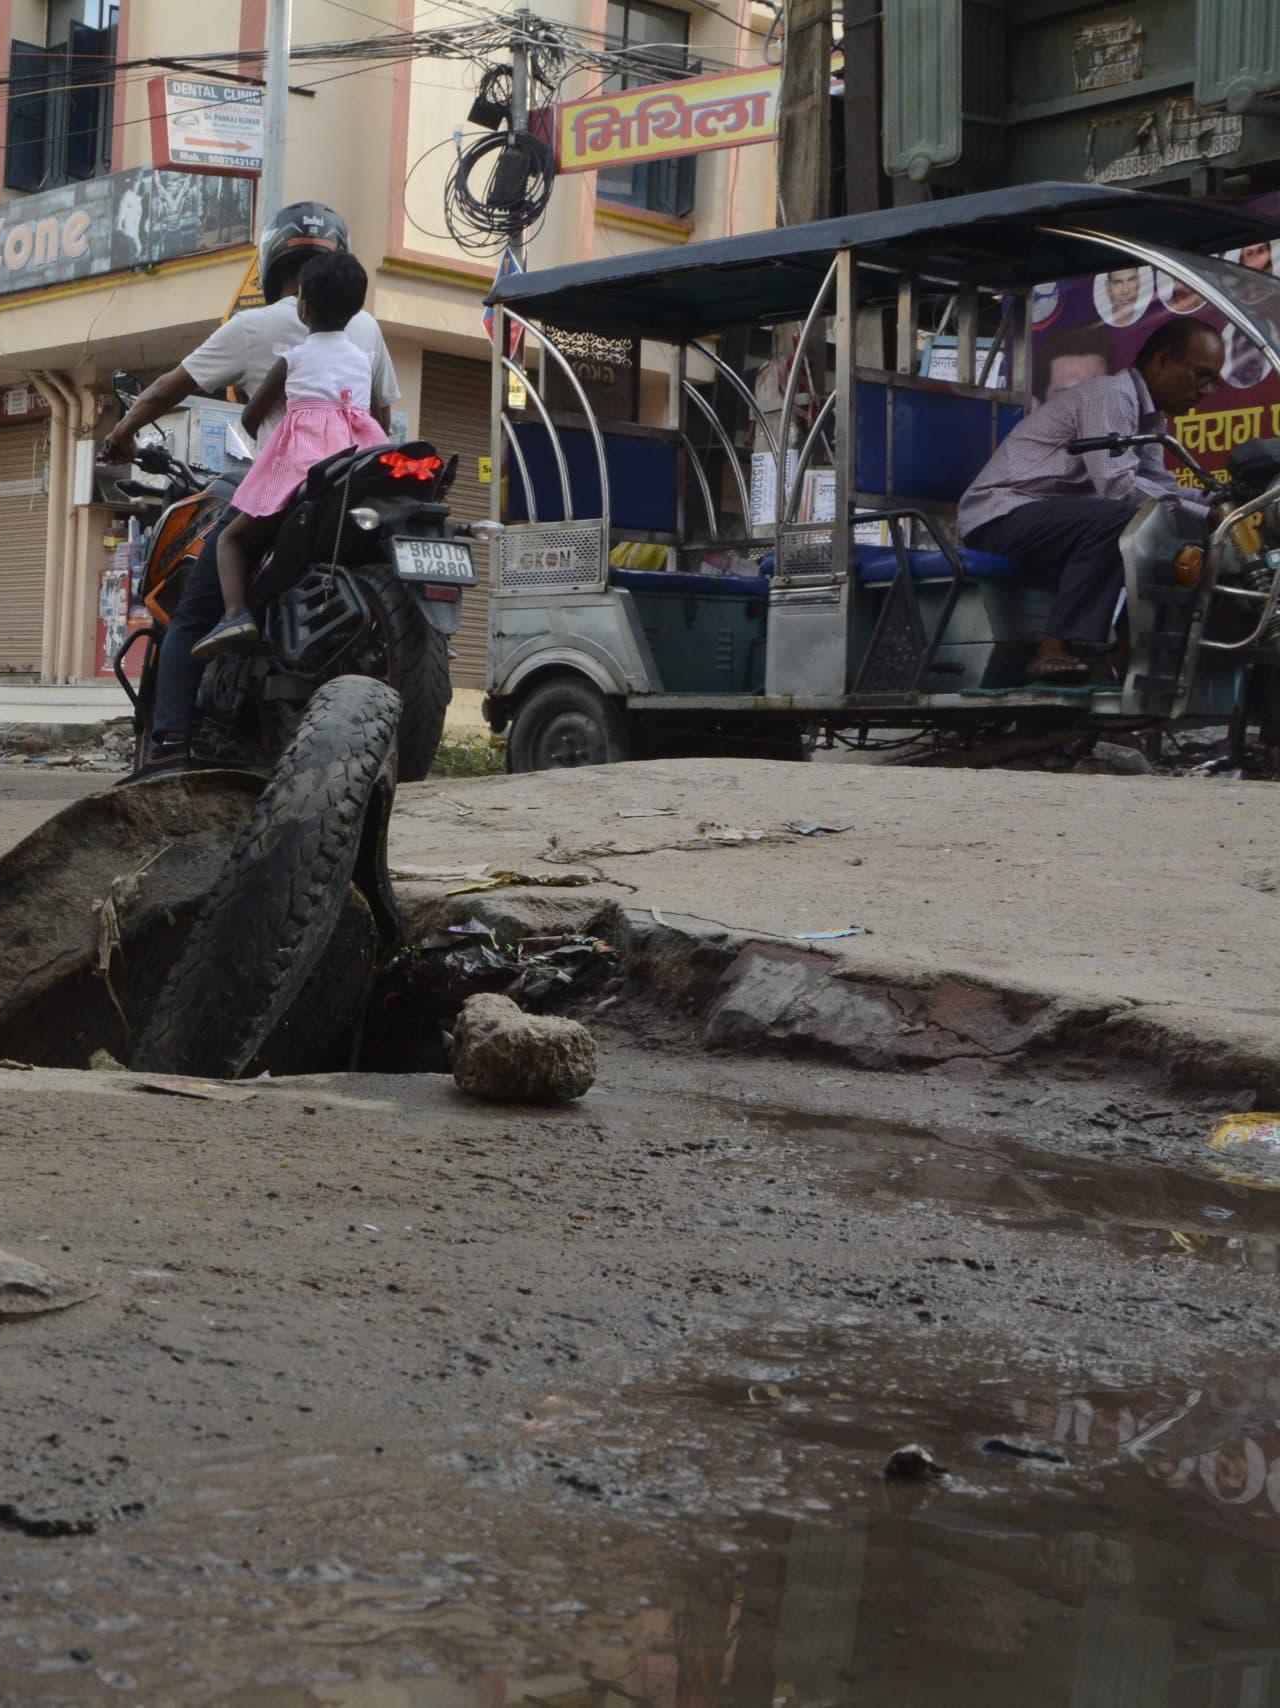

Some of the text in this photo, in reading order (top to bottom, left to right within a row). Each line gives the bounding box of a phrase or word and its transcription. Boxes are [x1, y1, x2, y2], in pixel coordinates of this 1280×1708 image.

[172, 81, 261, 104] DENTAL CLINIC
[203, 112, 213, 121] Dr.
[571, 91, 772, 157] मिथिला
